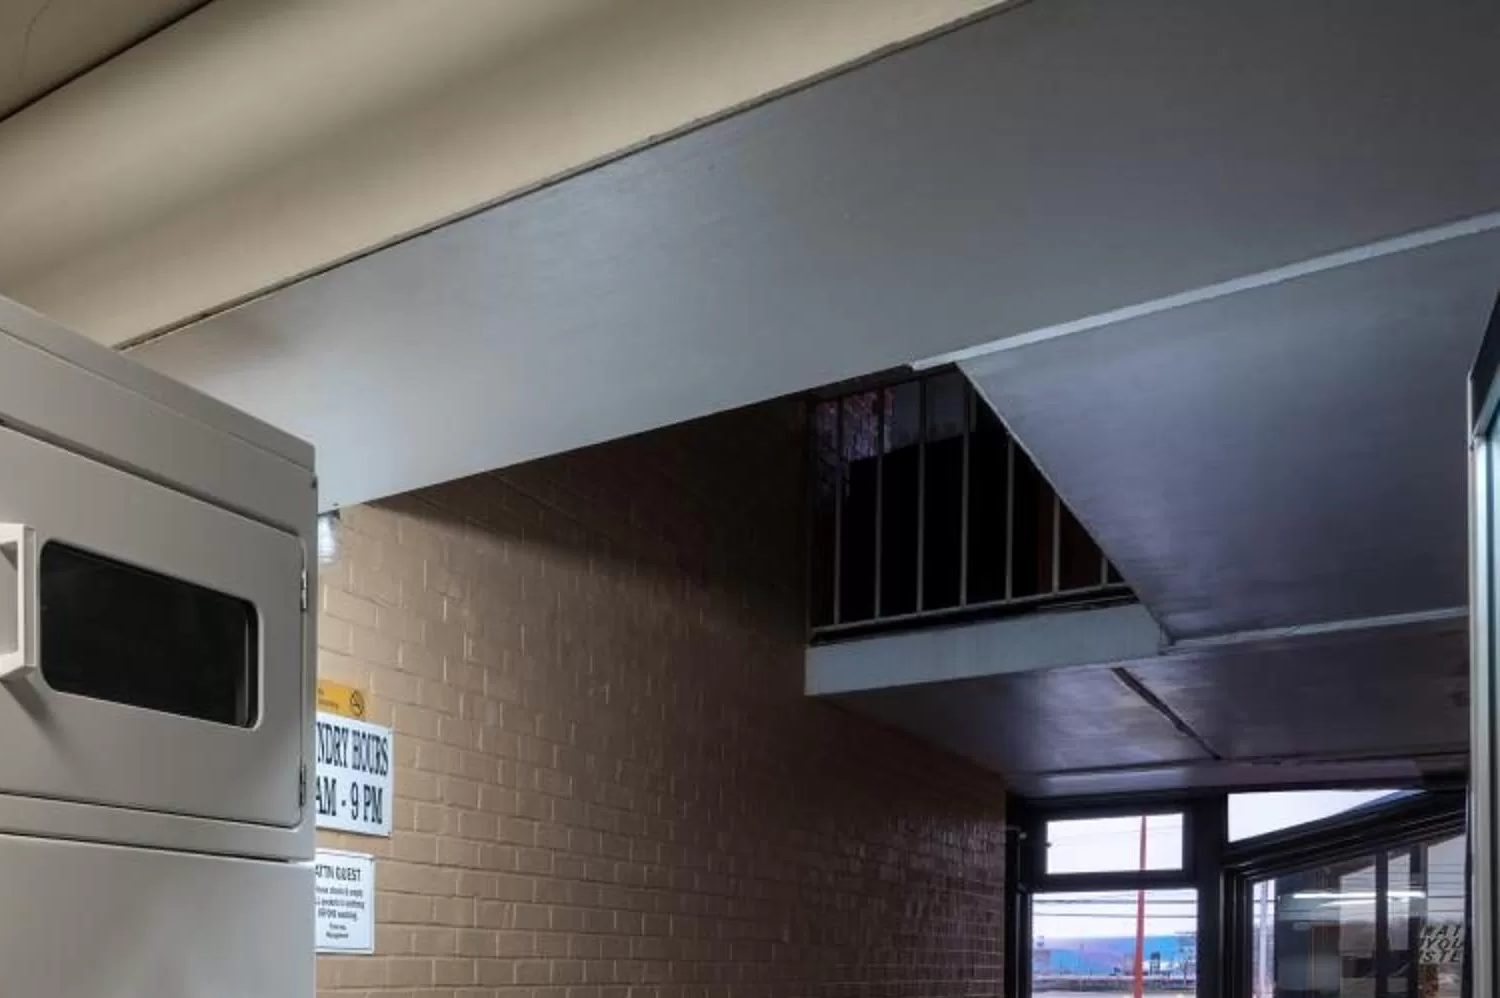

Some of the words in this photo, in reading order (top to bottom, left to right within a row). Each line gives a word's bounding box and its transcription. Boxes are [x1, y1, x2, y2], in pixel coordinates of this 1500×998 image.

[316, 721, 349, 769] NDRY
[351, 729, 389, 776] HOURS
[351, 781, 359, 821] 9
[363, 784, 383, 825] PM
